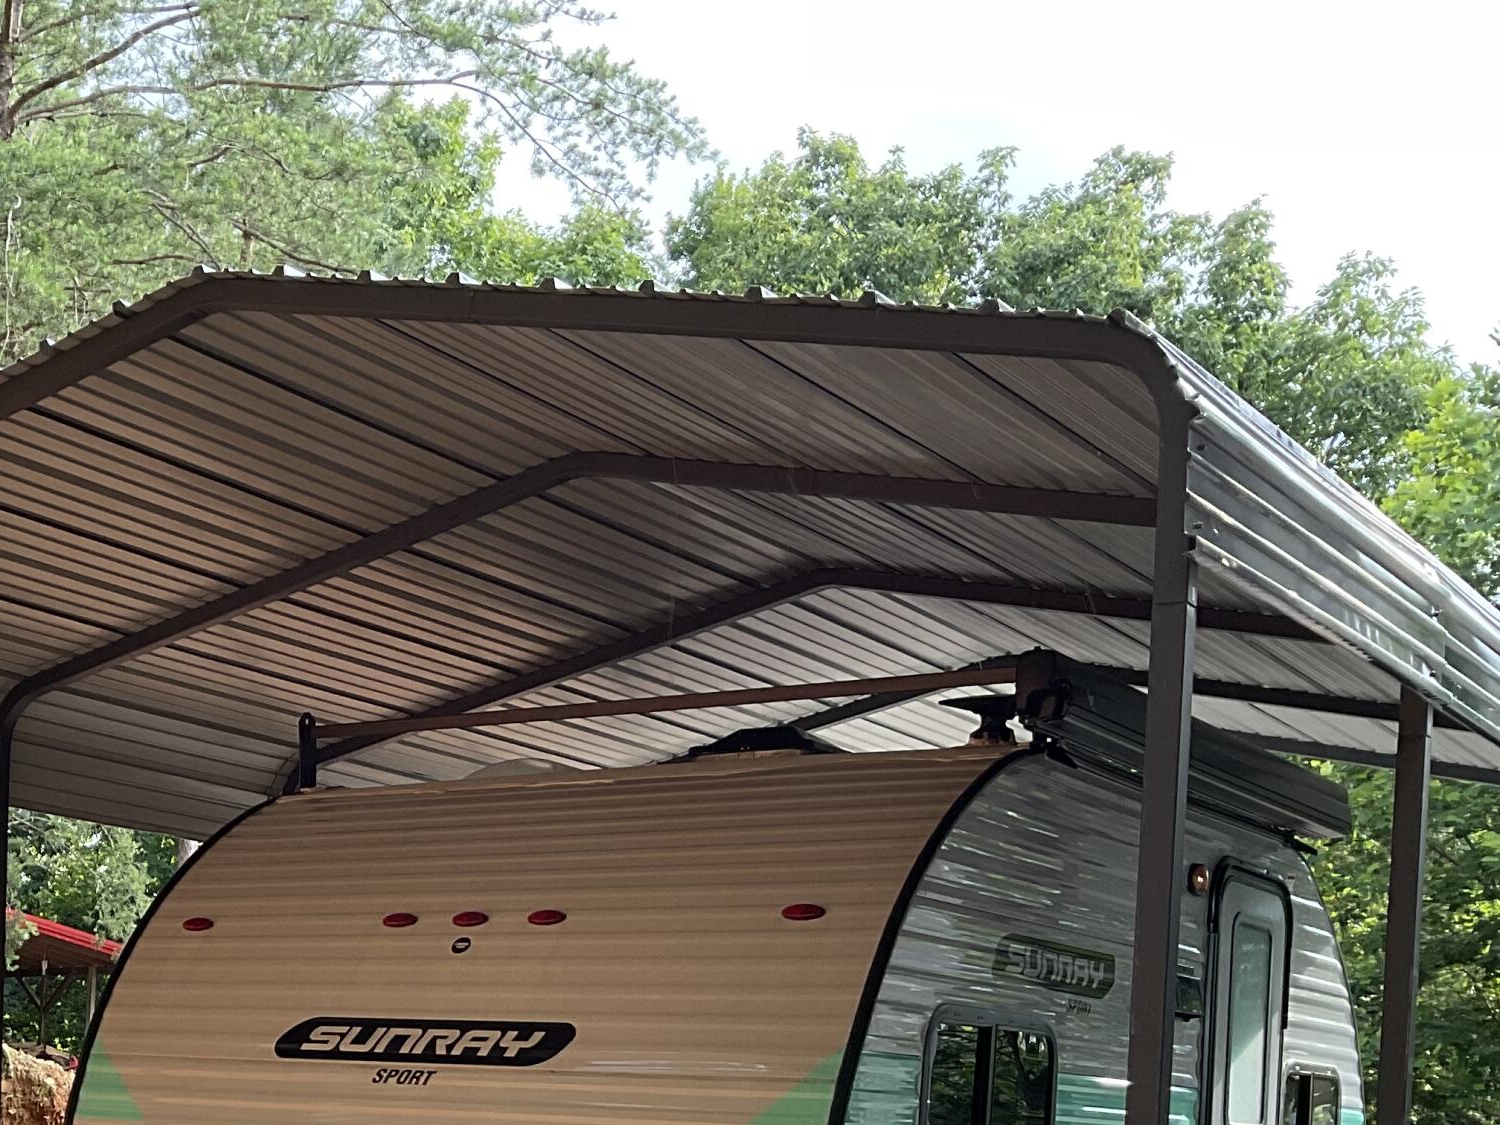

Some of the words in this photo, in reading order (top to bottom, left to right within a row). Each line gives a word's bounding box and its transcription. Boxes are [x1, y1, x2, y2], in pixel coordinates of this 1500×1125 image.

[1004, 943, 1105, 989] SUNRAY
[300, 1025, 547, 1058] SUNRAY
[371, 1068, 438, 1086] SPORT
